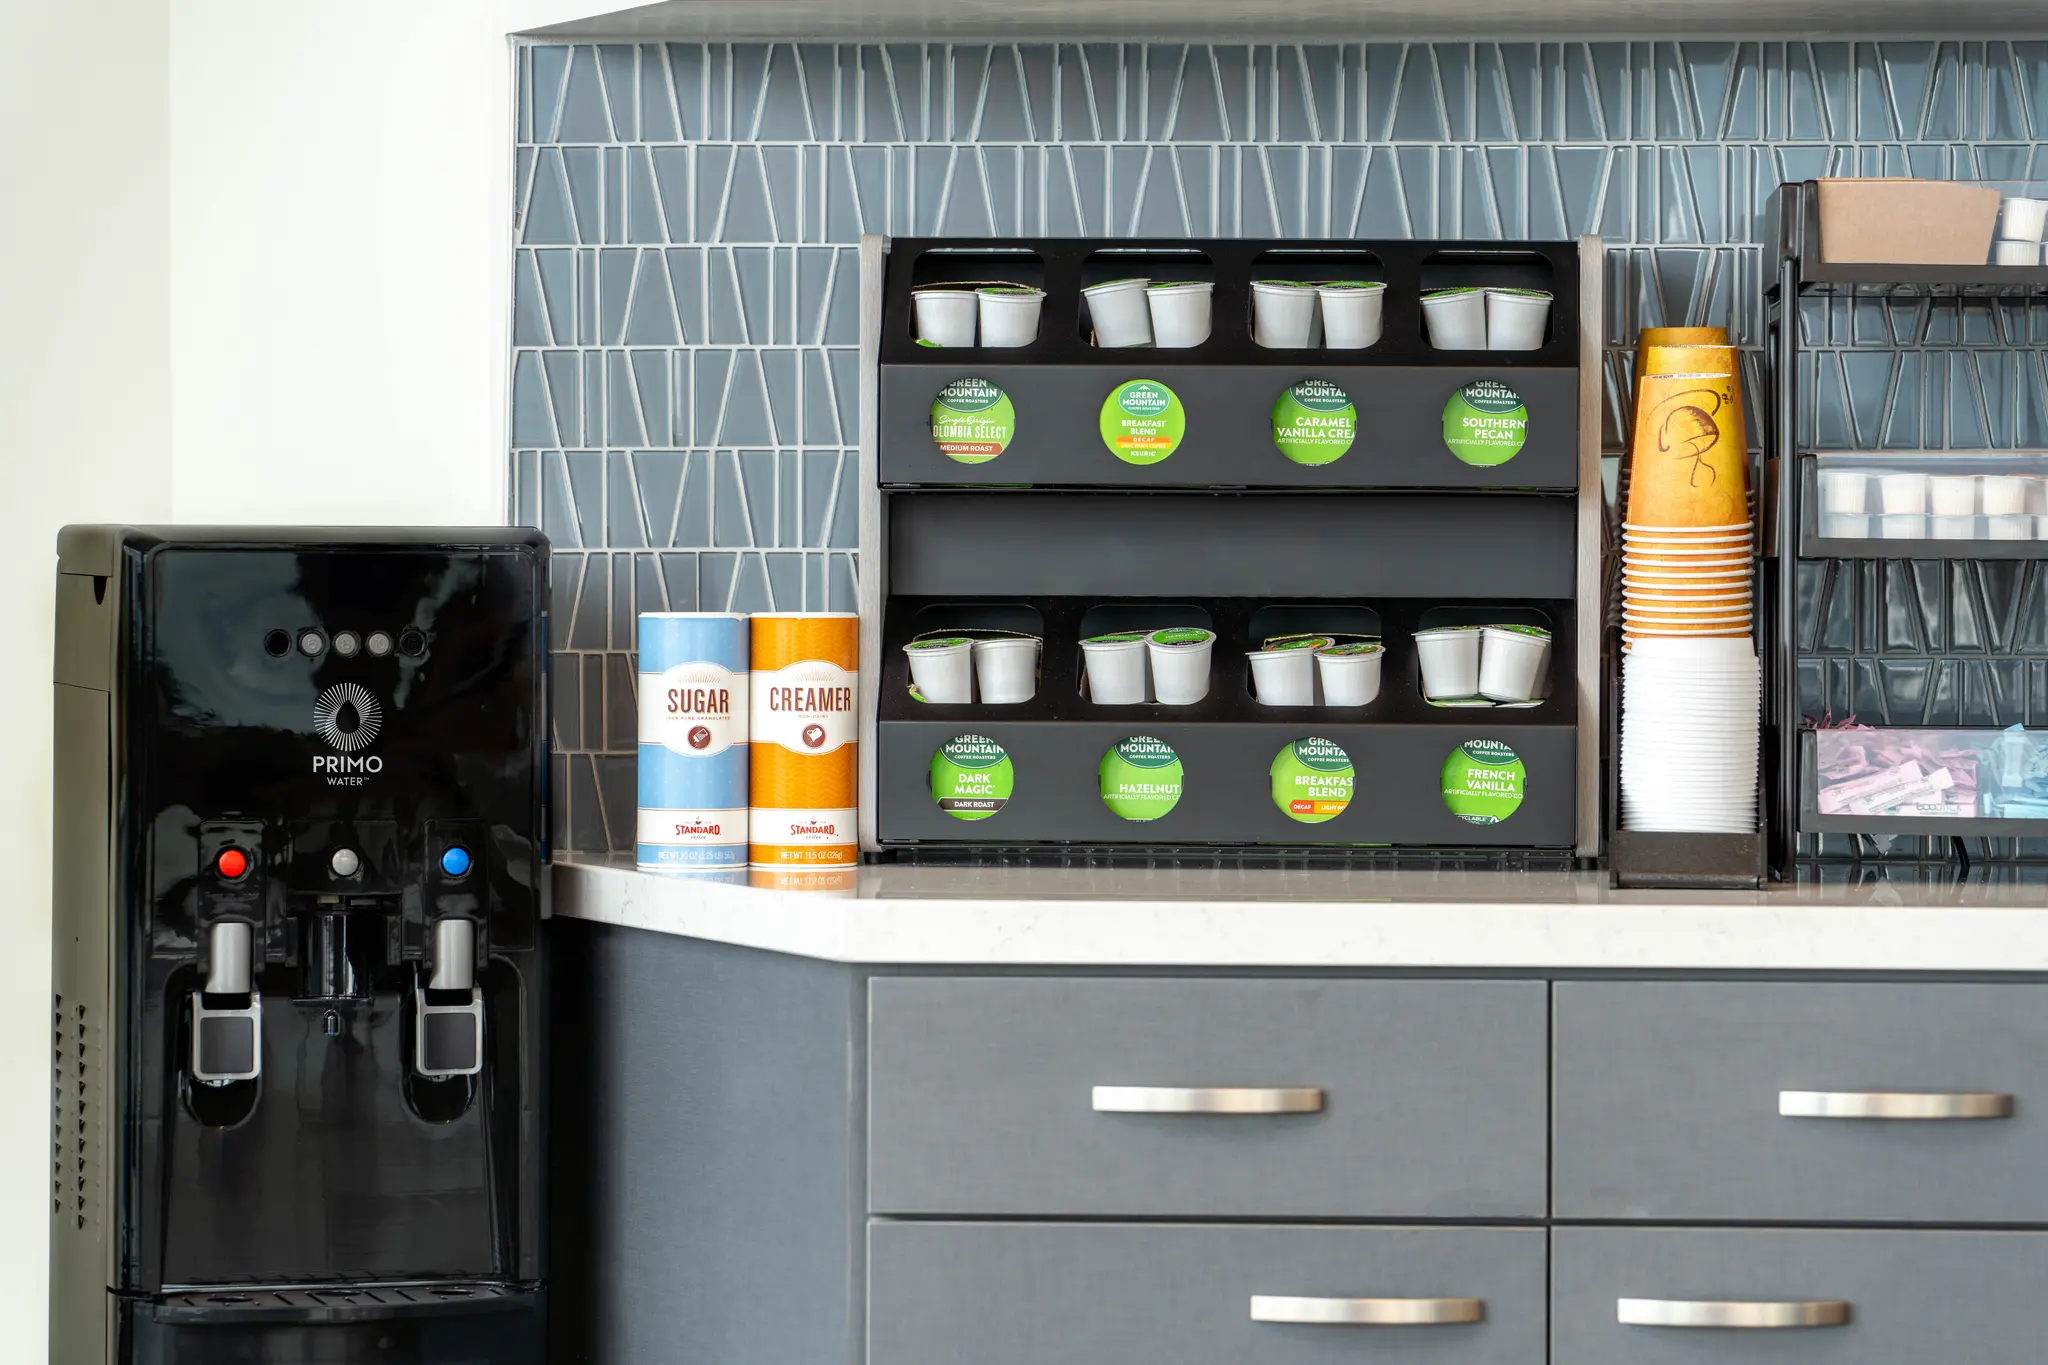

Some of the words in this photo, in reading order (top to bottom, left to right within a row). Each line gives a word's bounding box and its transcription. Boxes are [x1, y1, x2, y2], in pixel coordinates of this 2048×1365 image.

[938, 388, 997, 398] MOUNTAIN
[1296, 417, 1352, 427] CARAMEL
[1462, 418, 1526, 428] SOUTHERN
[933, 425, 972, 438] OLOMBIA
[975, 426, 1007, 438] SELECT
[1277, 428, 1326, 438] VANILLA
[1474, 429, 1513, 439] PECAN
[668, 688, 729, 713] SUGAR
[770, 687, 851, 712] CREAMER
[946, 744, 1005, 753] MOUNTAIN
[313, 756, 383, 773] PRIMO
[959, 774, 991, 783] DARK
[1468, 768, 1516, 780] FRENCH
[1295, 776, 1353, 786] BREAKFAS
[1466, 780, 1515, 792] VANILLA
[955, 785, 993, 794] MAGIC
[1120, 784, 1180, 794] HAZELNUT
[1308, 787, 1346, 797] BLEND
[676, 824, 720, 835] STANDARD
[791, 824, 834, 835] STANDARD
[781, 852, 793, 860] NET
[794, 852, 803, 860] WT
[818, 852, 826, 860] OZ
